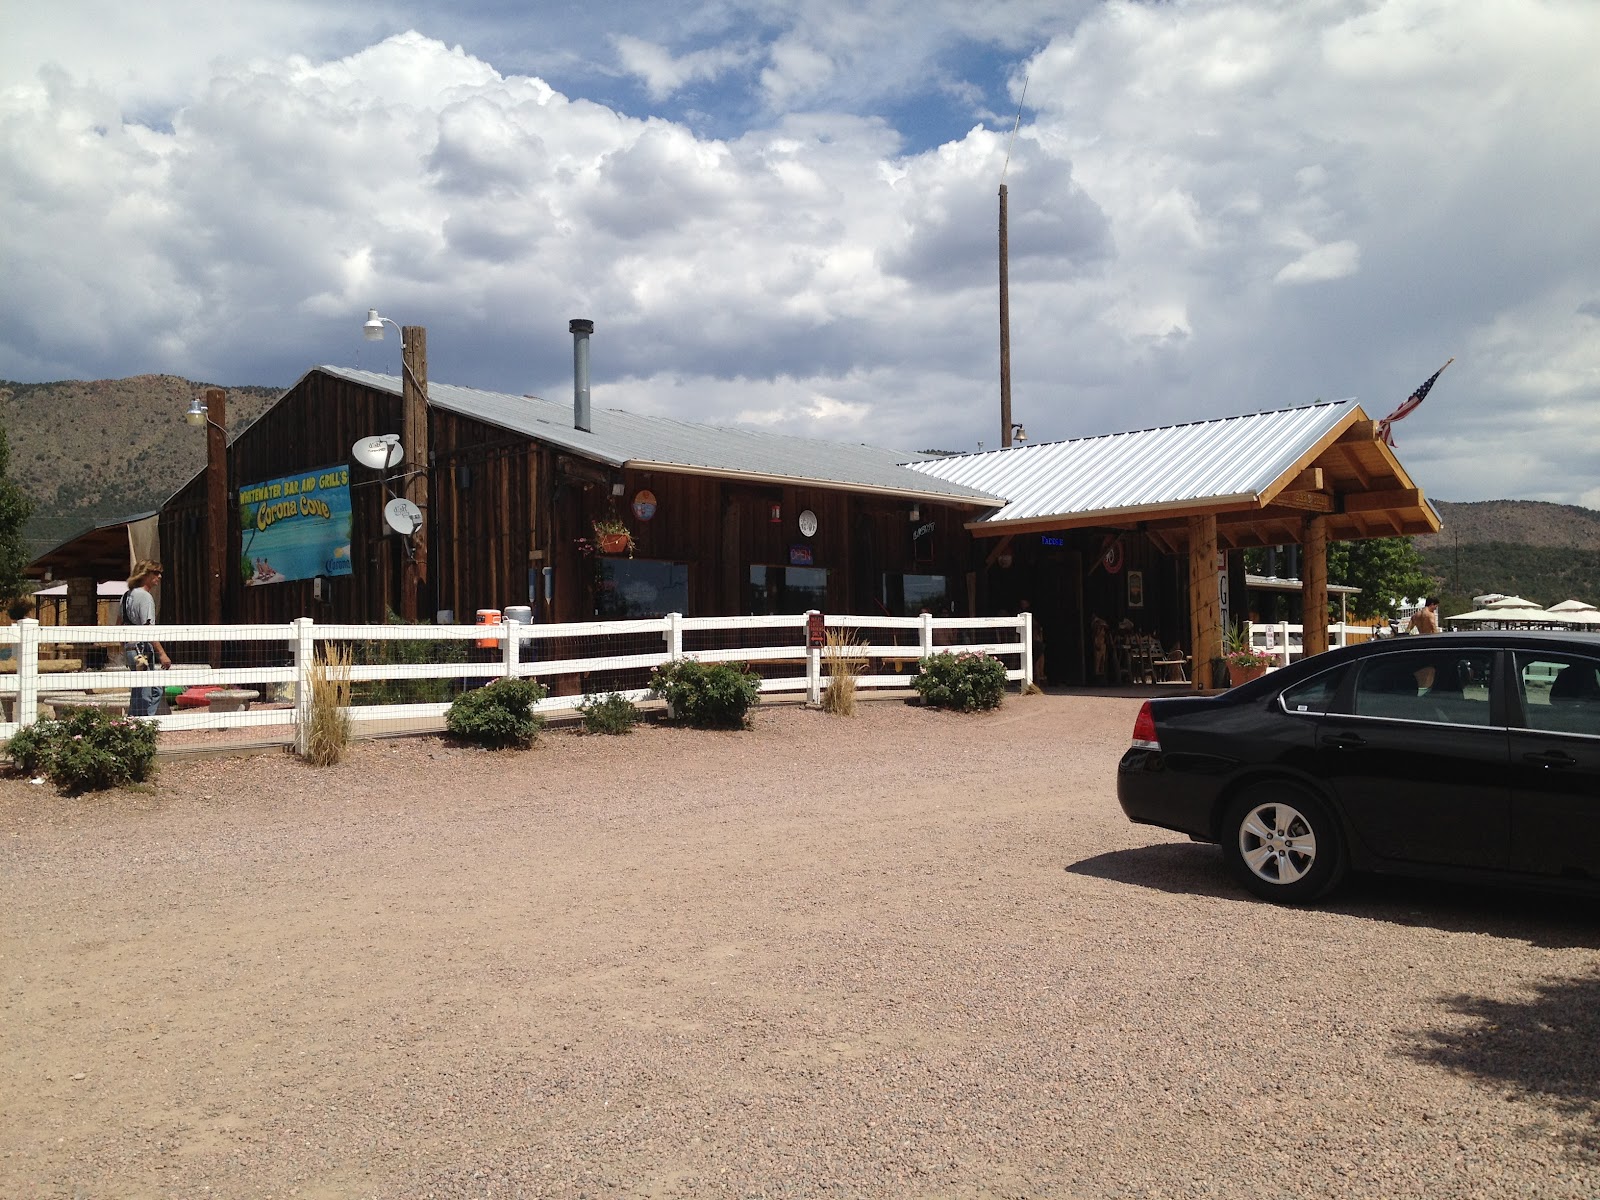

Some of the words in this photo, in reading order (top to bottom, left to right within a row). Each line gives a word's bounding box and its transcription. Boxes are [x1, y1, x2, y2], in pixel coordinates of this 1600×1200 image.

[239, 484, 282, 505] WHITEWATER
[283, 480, 300, 497] BAR
[301, 476, 317, 494] AND
[319, 470, 348, 491] GRILL'S
[257, 502, 298, 533] Corona
[300, 496, 331, 520] Cove
[790, 549, 812, 560] OPEN
